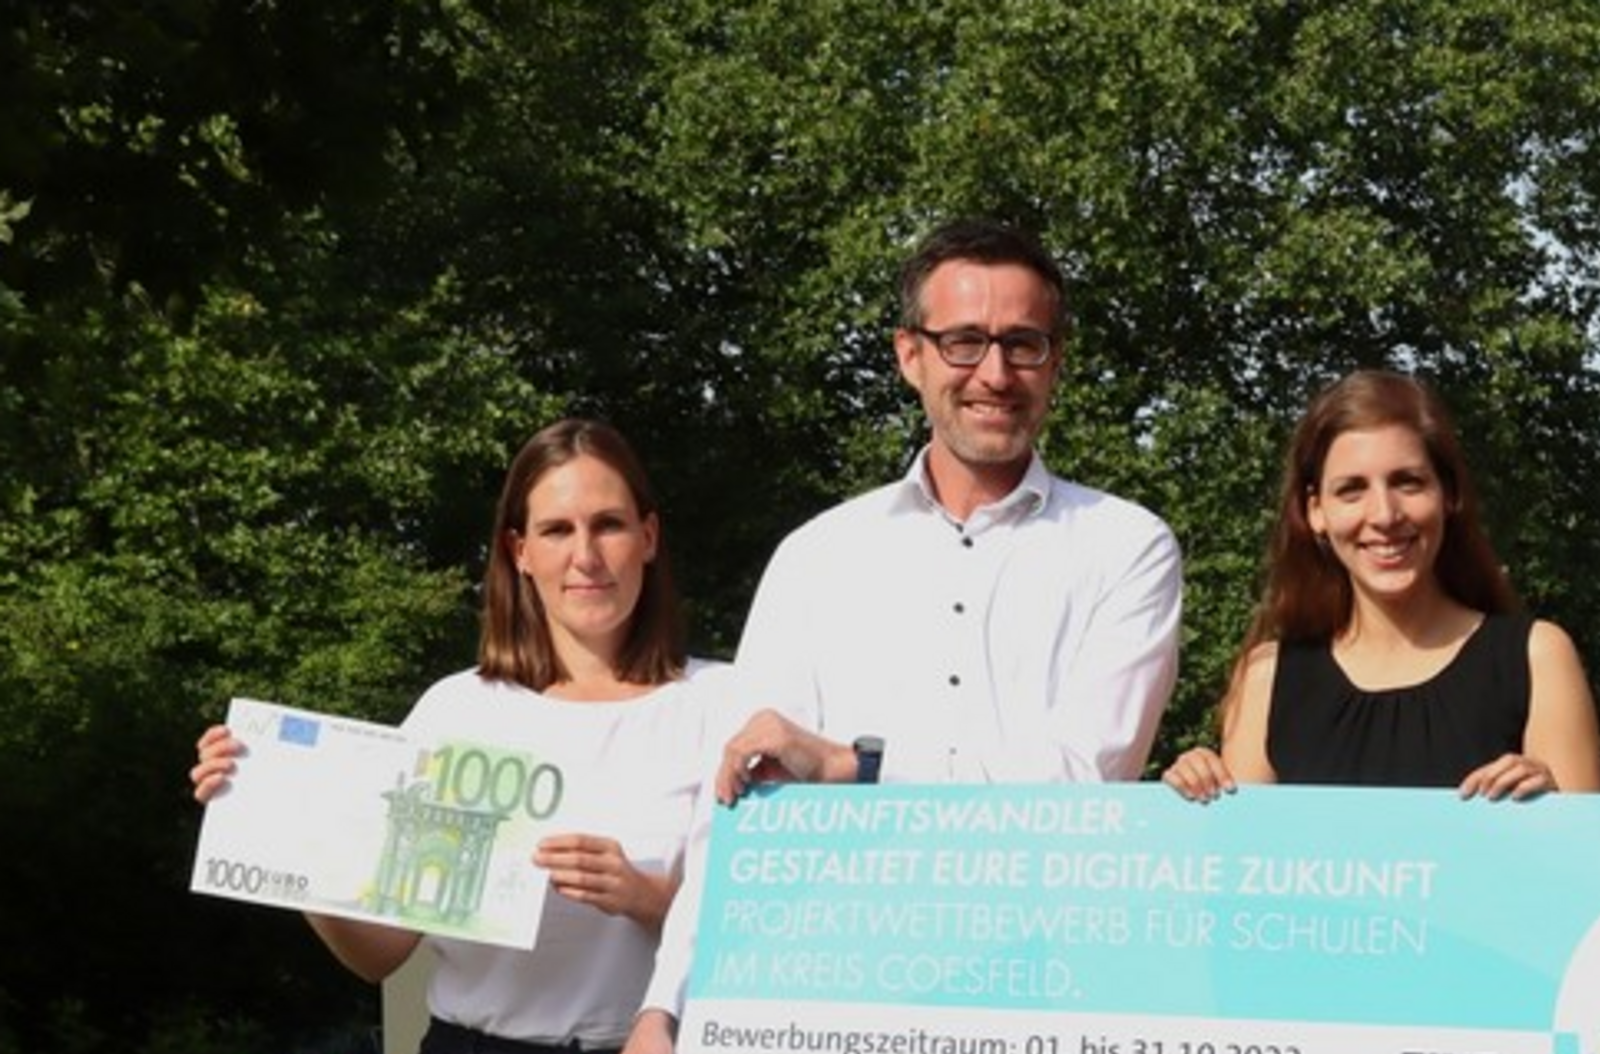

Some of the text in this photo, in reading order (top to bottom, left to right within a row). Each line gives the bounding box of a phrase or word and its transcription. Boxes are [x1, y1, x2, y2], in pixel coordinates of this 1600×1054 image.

[434, 746, 564, 820] 1000
[737, 796, 1126, 835] ZUKUNFTSWANDLER
[205, 857, 263, 894] 1000
[730, 848, 1438, 898] GESTALTET EURE DIGITALE ZUKUNFT
[720, 899, 1428, 956] PROJEKTWETTBEWERB FÜR SCHULEN
[714, 952, 1086, 1000] IM KREIS COESFELD.
